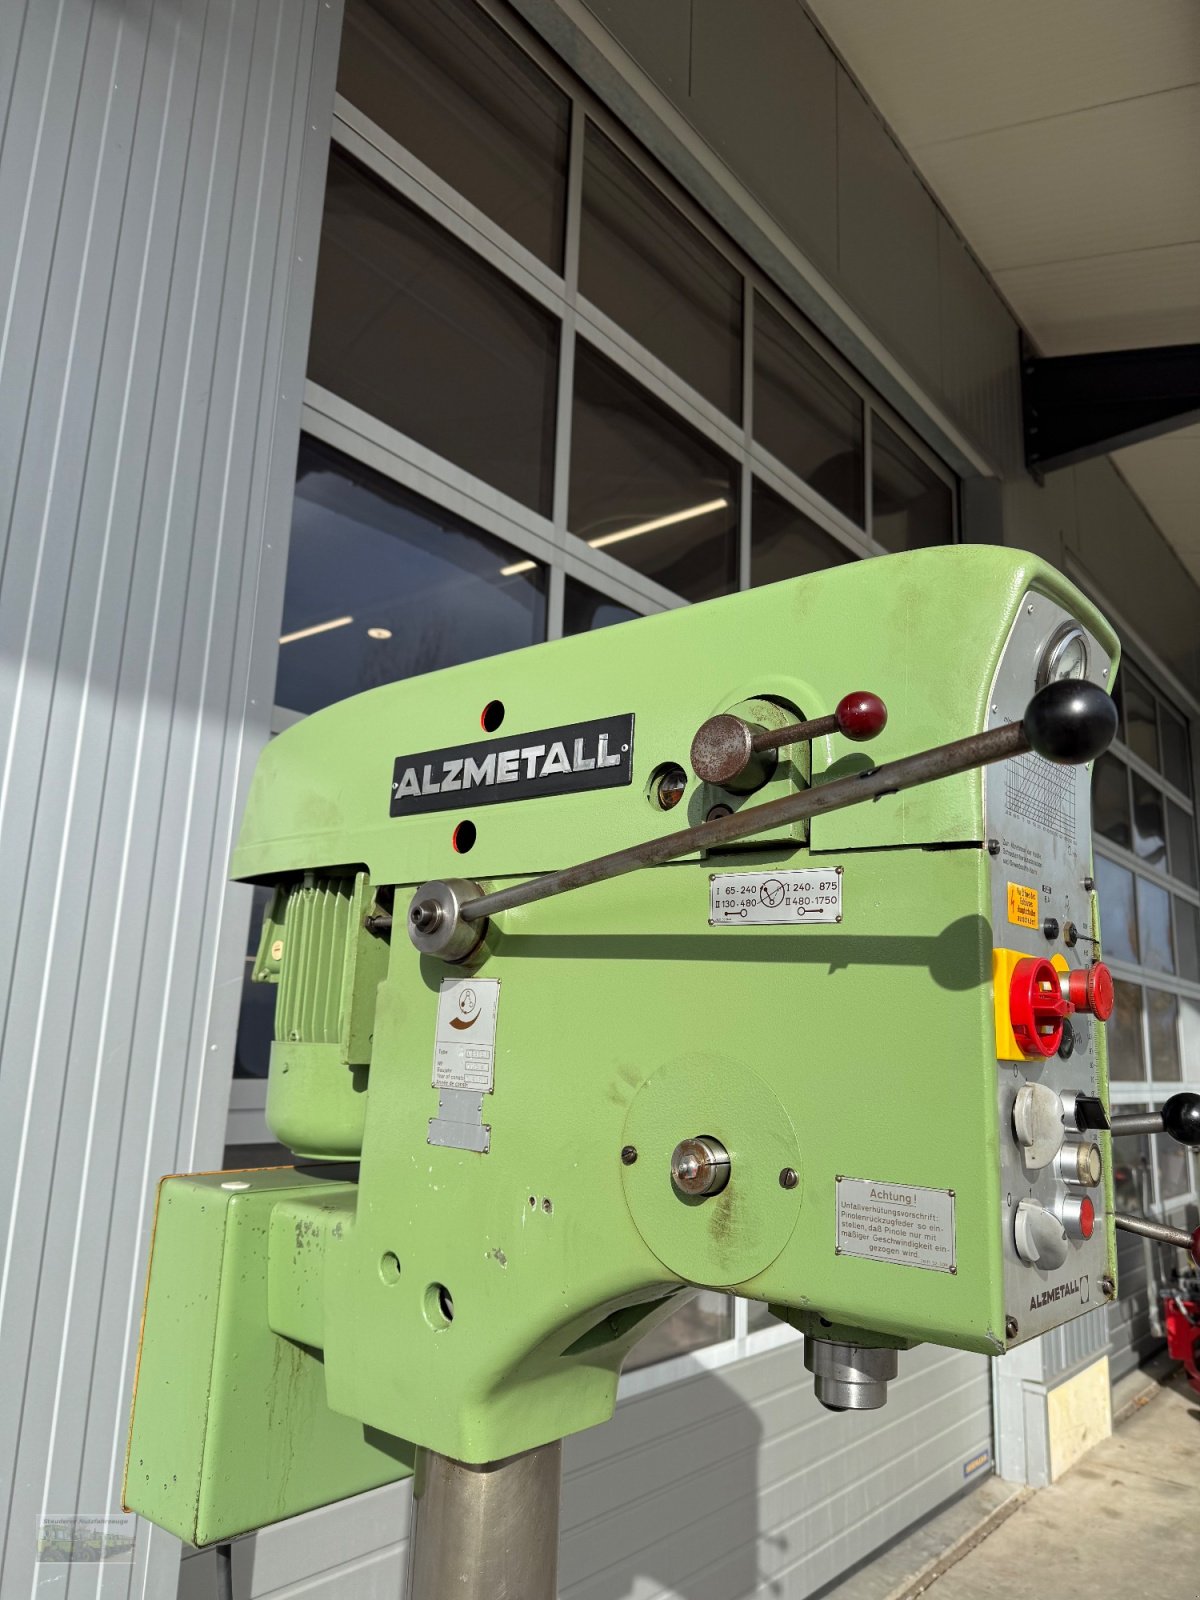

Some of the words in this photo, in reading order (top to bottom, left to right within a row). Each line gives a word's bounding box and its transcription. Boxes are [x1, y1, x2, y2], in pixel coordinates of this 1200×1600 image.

[394, 733, 621, 799] ALZMETALL
[870, 1188, 912, 1204] Achtung
[884, 1226, 907, 1237] Pinole
[909, 1231, 922, 1239] nur
[924, 1233, 937, 1241] mit
[869, 1244, 900, 1255] gezogen
[1029, 1279, 1080, 1312] ALZMETALL
